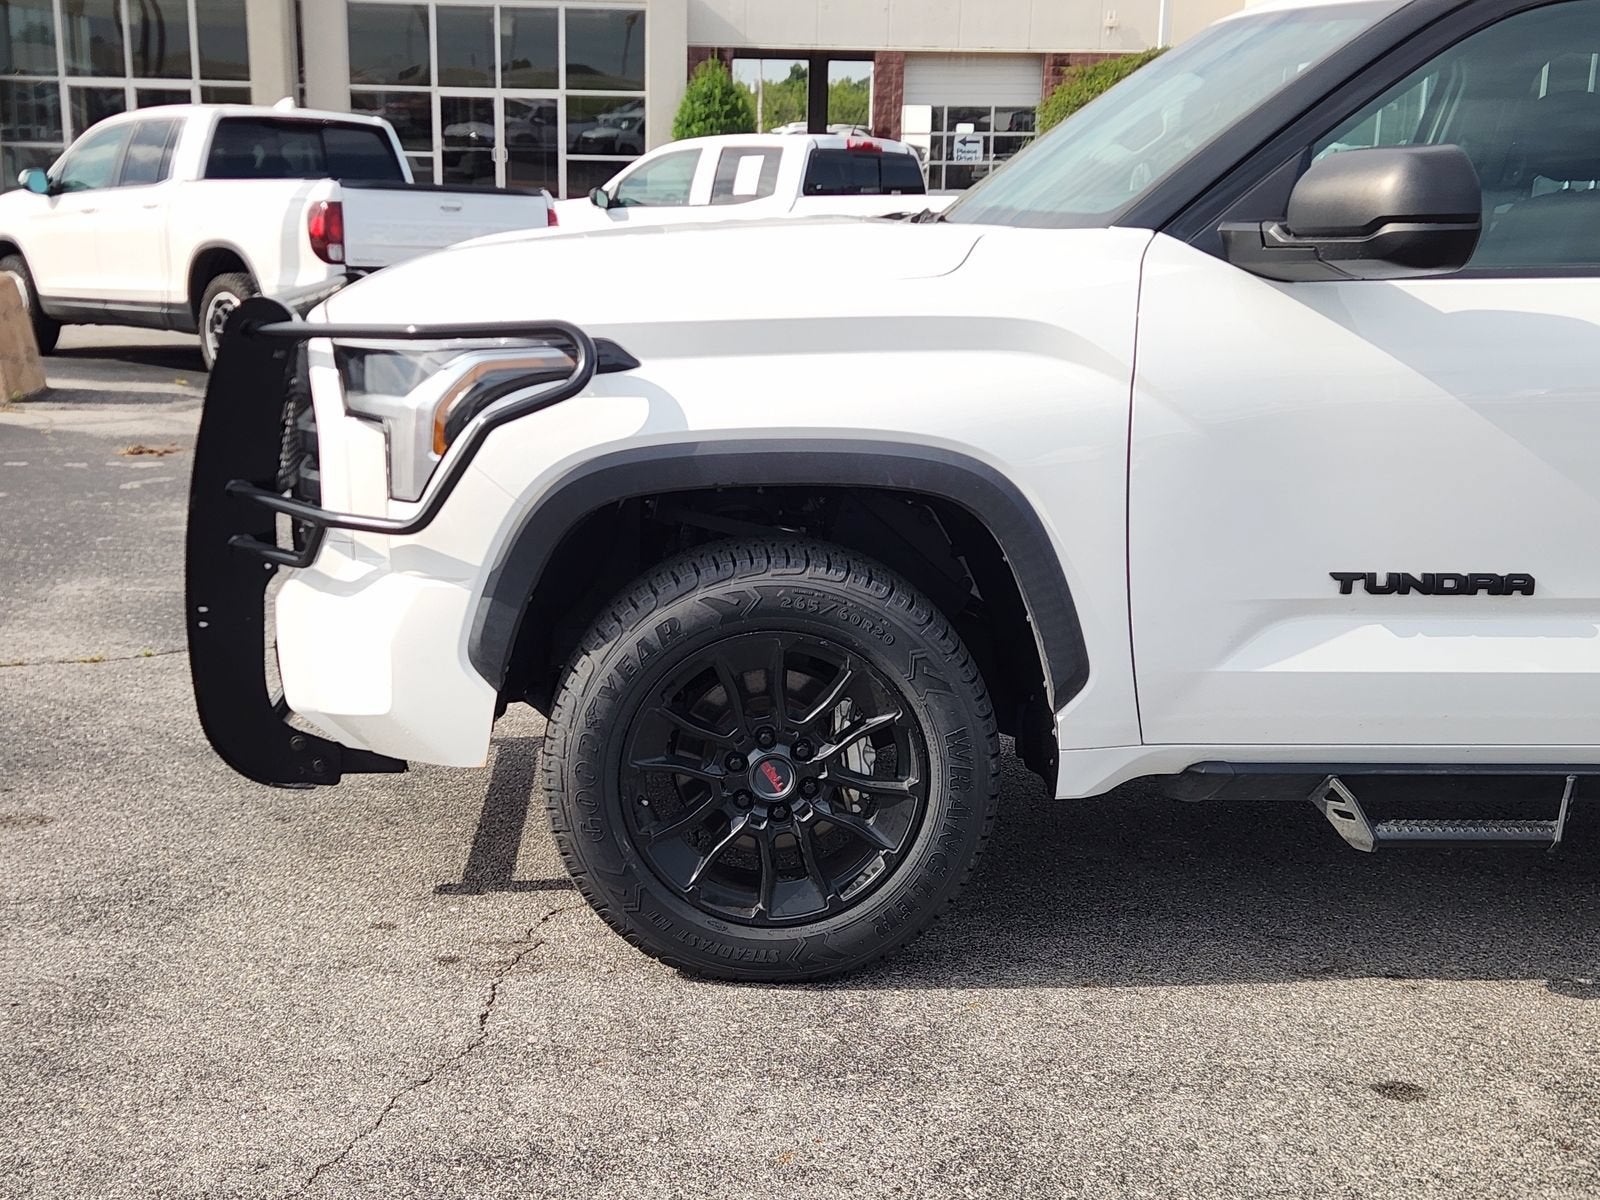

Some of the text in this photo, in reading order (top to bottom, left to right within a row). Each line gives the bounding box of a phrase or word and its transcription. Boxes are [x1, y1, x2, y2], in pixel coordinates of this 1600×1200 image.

[1329, 572, 1536, 596] TUNDRA
[780, 595, 895, 645] 265/60R20
[868, 725, 975, 939] WRANGLER
[674, 926, 781, 964] STEADFAST
